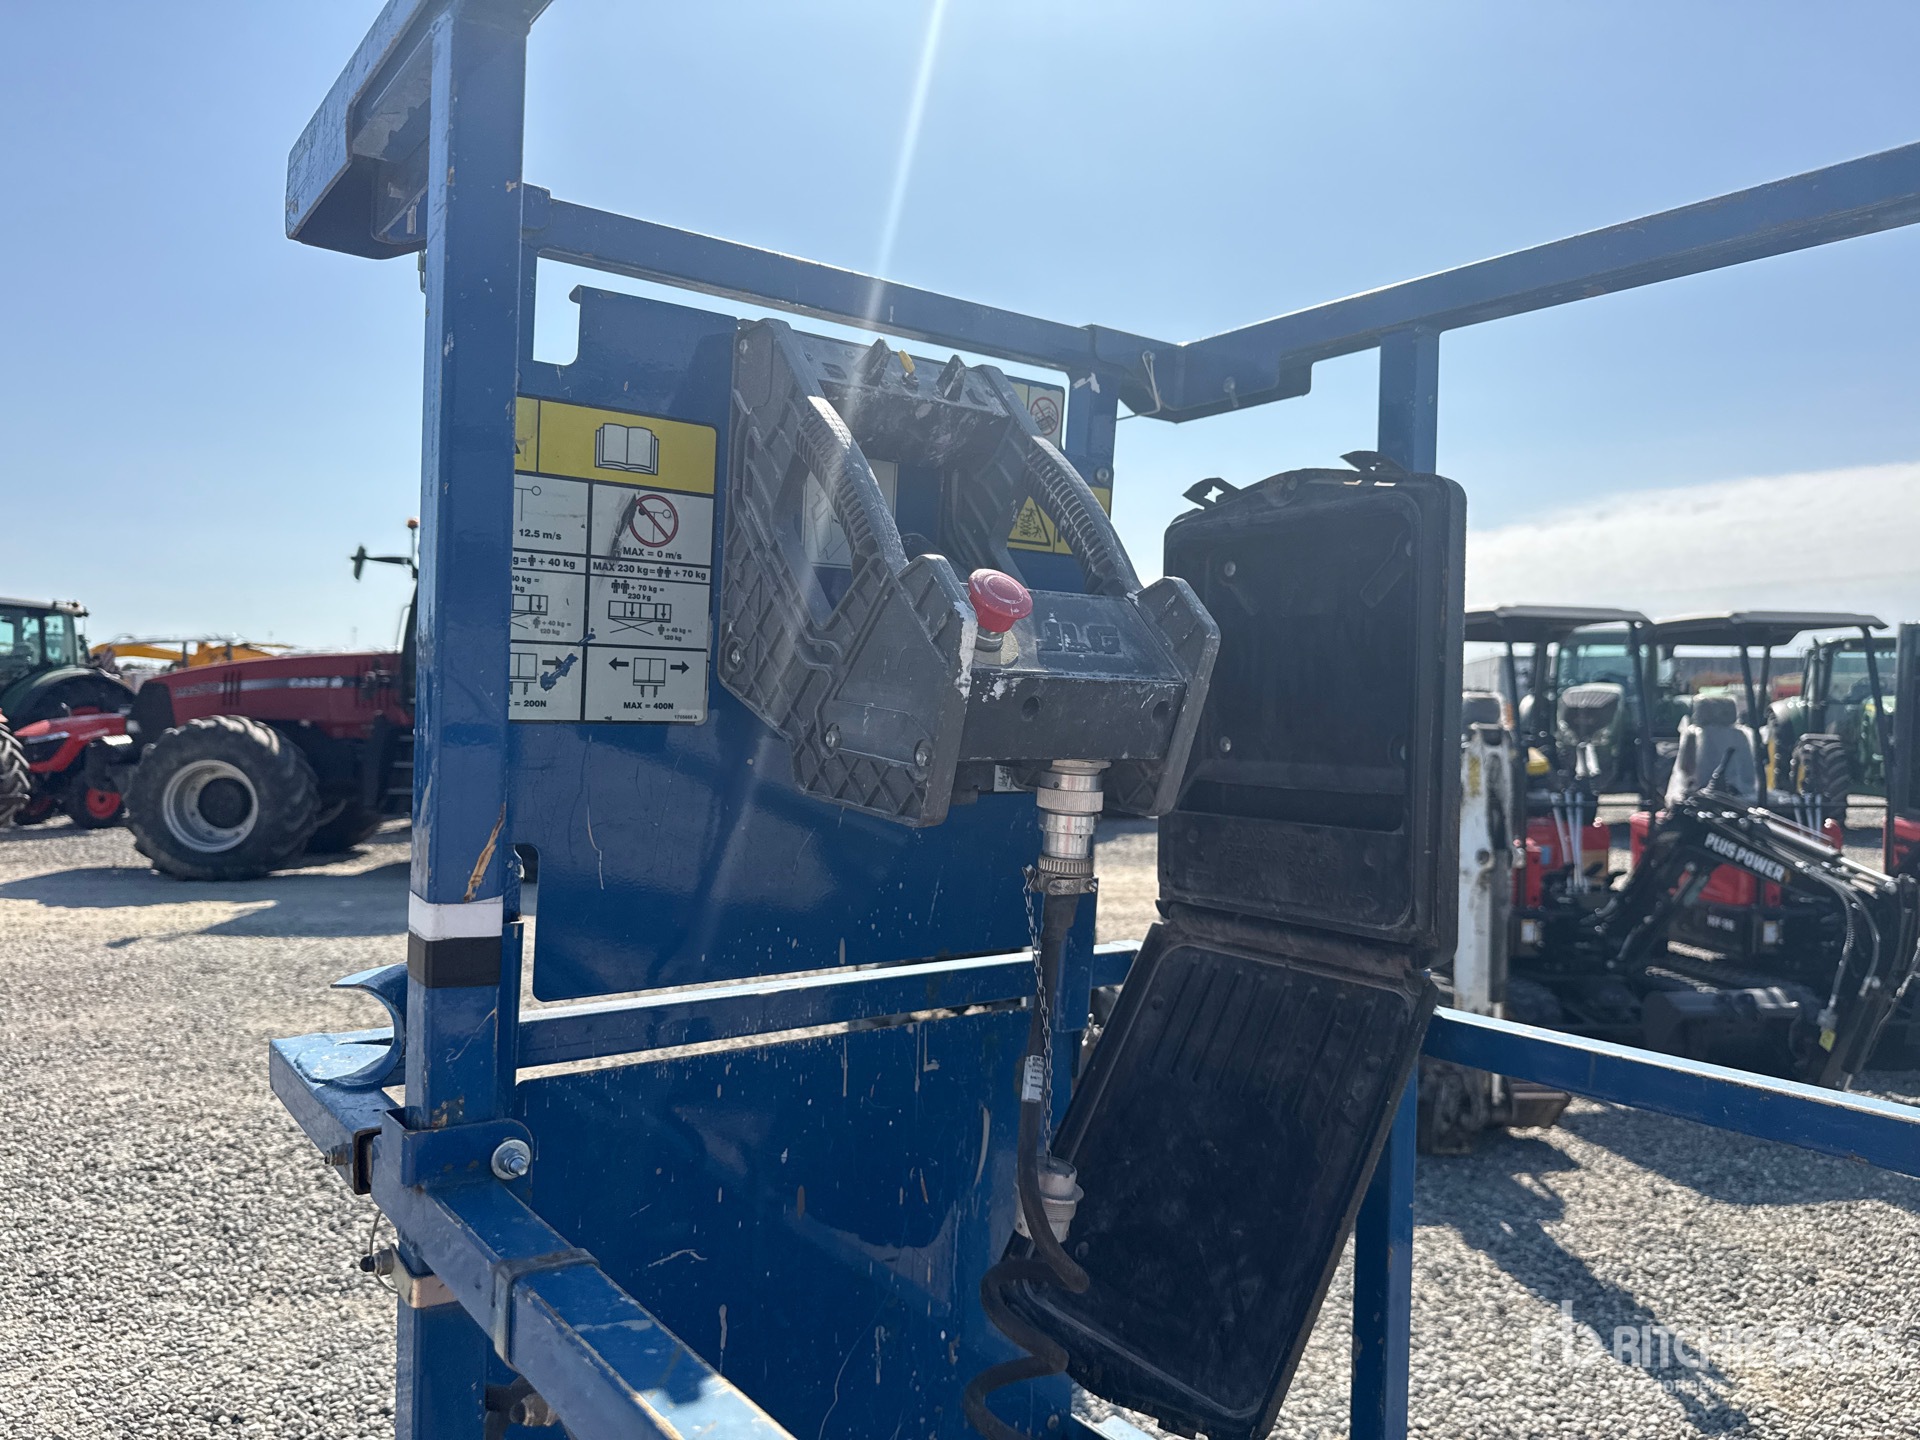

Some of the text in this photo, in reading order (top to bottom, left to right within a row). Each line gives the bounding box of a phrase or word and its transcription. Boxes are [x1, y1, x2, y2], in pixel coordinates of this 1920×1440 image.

[519, 529, 562, 541] 12.5 m/s
[623, 547, 645, 557] MAX
[657, 550, 663, 559] 0
[665, 550, 682, 560] m/s
[548, 559, 561, 568] 40
[564, 560, 575, 569] kg
[593, 562, 615, 572] MAX
[617, 564, 635, 573] 230
[682, 570, 694, 578] 70
[696, 571, 706, 580] kg
[522, 576, 532, 585] kg
[515, 585, 525, 593] kg
[649, 585, 658, 593] kg
[642, 594, 652, 602] kg
[1036, 622, 1122, 655] JLG
[524, 700, 547, 708] 200N
[624, 702, 643, 710] MAX
[653, 702, 674, 710] 400N
[1703, 831, 1786, 882] PLUS POWER
